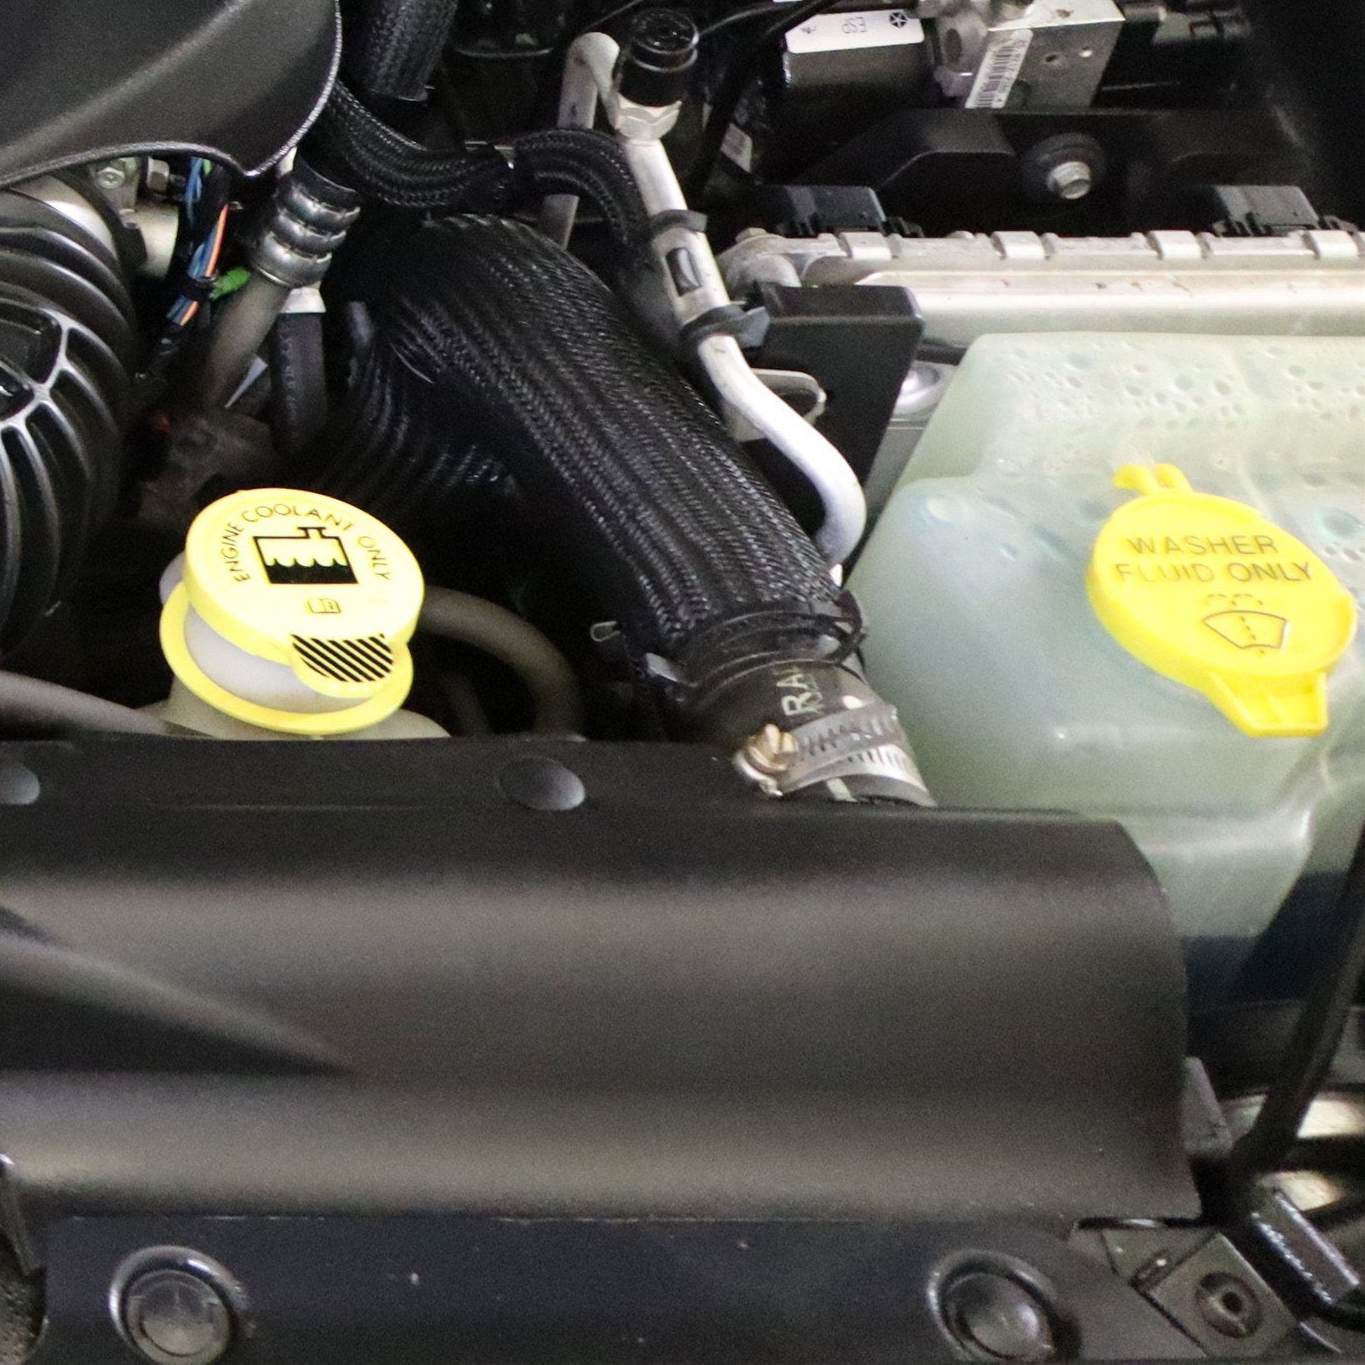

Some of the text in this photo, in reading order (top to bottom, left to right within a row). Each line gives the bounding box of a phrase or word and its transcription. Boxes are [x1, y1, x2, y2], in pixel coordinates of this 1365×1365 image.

[220, 503, 392, 583] ENGINE COOLANT ONLY
[1126, 535, 1279, 555] WASHER
[1114, 561, 1312, 583] FLUID ONLY
